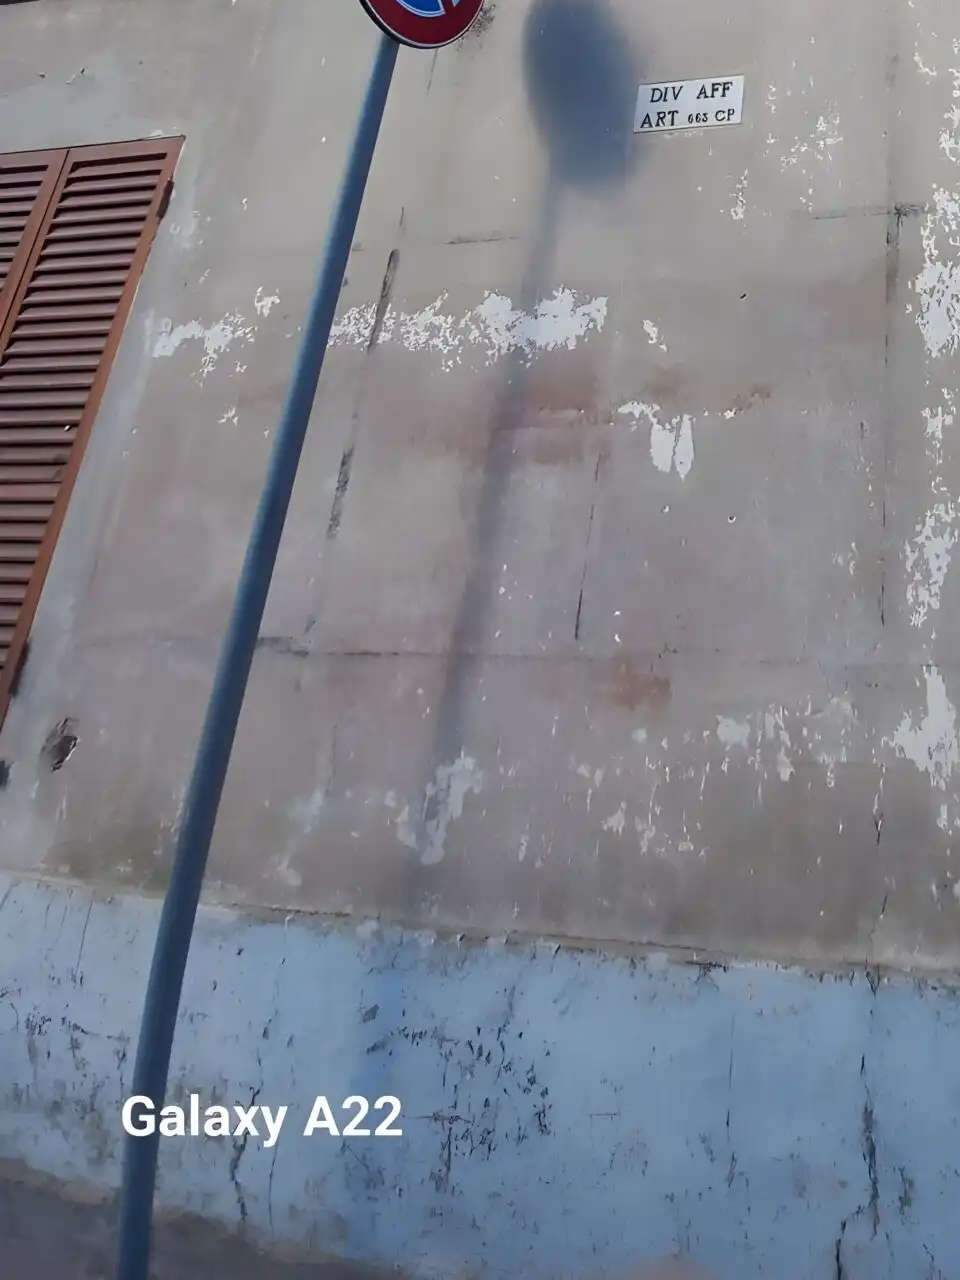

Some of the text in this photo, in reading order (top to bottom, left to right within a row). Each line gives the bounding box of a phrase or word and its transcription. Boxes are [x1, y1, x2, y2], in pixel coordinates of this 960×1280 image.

[649, 81, 733, 103] DIV AFF
[640, 110, 679, 129] ART
[714, 108, 735, 122] CP
